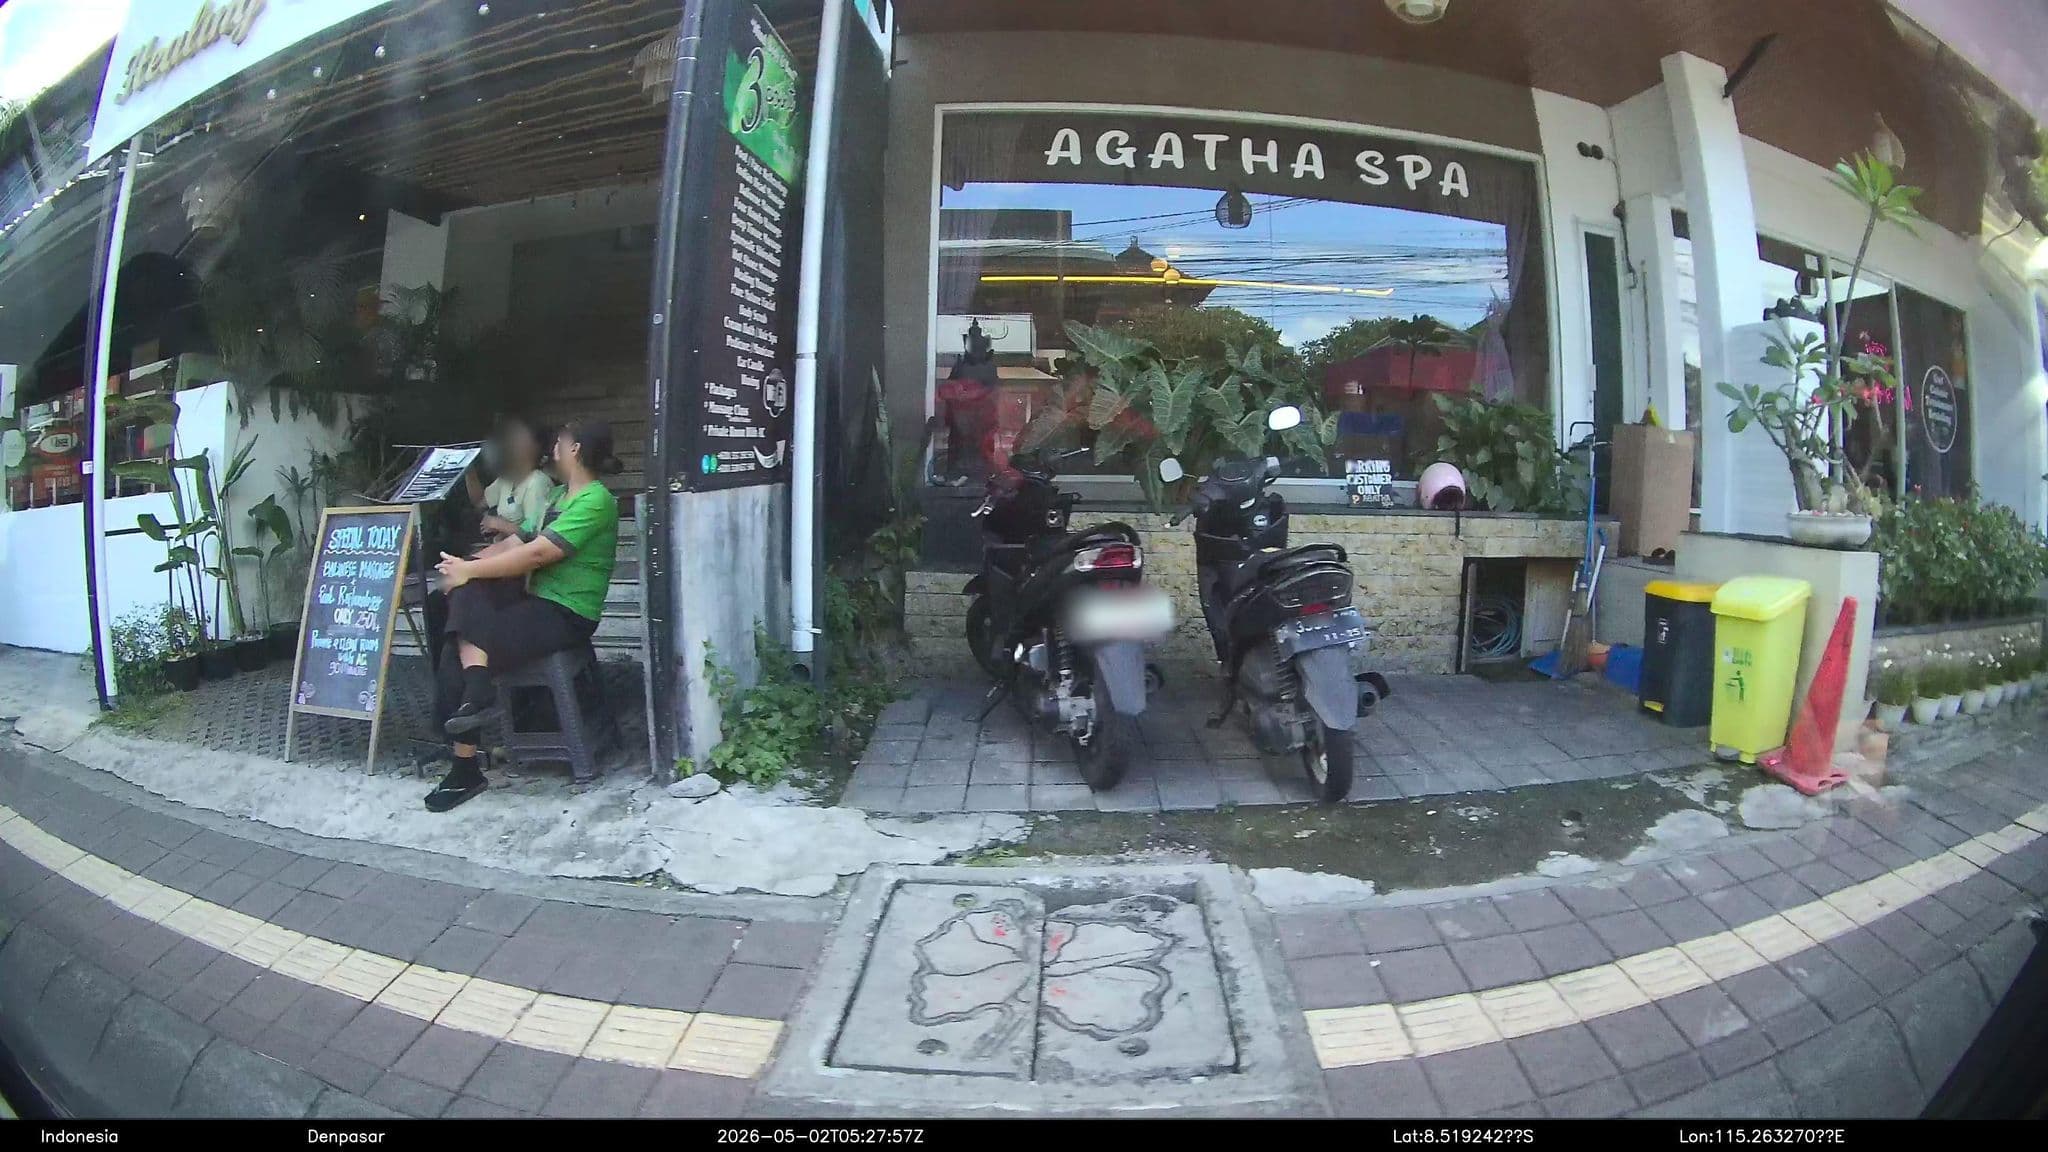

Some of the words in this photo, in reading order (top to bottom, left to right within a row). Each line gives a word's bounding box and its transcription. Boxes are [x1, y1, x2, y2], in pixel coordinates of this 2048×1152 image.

[1045, 129, 1324, 179] AGATHA
[1356, 151, 1468, 197] SPA
[1357, 485, 1382, 496] ONLY
[367, 524, 402, 550] TODAY
